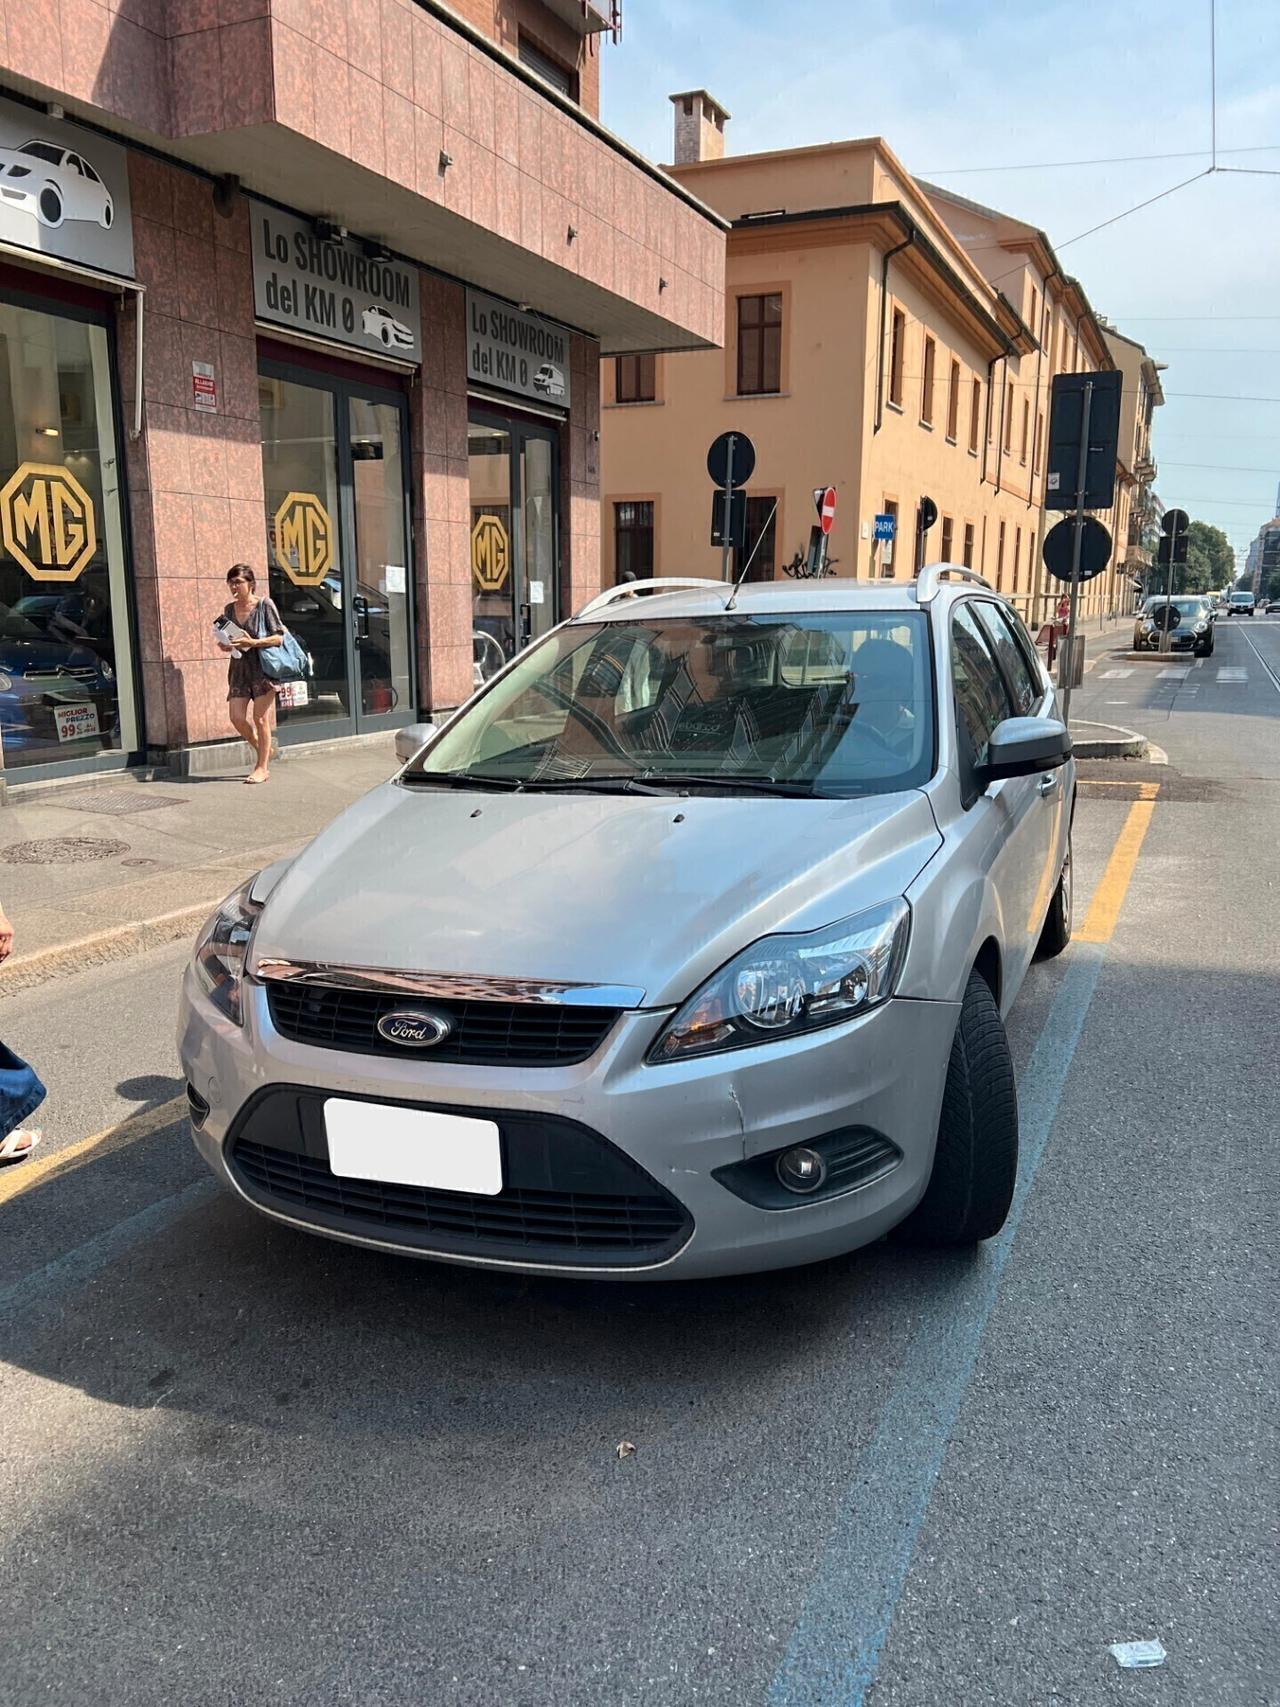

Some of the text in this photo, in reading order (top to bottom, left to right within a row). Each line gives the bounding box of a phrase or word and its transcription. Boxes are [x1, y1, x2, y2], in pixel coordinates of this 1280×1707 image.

[263, 218, 411, 309] Lo SHOWROOM
[265, 272, 299, 317] del
[304, 283, 337, 329] KM
[472, 302, 564, 364] Lo SHOWROOM
[472, 341, 493, 376] del
[496, 349, 516, 385] KM
[13, 479, 85, 565] MG
[282, 505, 326, 573] MG
[874, 521, 894, 533] PARK
[476, 525, 505, 579] MG
[58, 708, 87, 718] MIGLIOR
[66, 714, 95, 723] PREZZO
[390, 1019, 427, 1040] Ford
